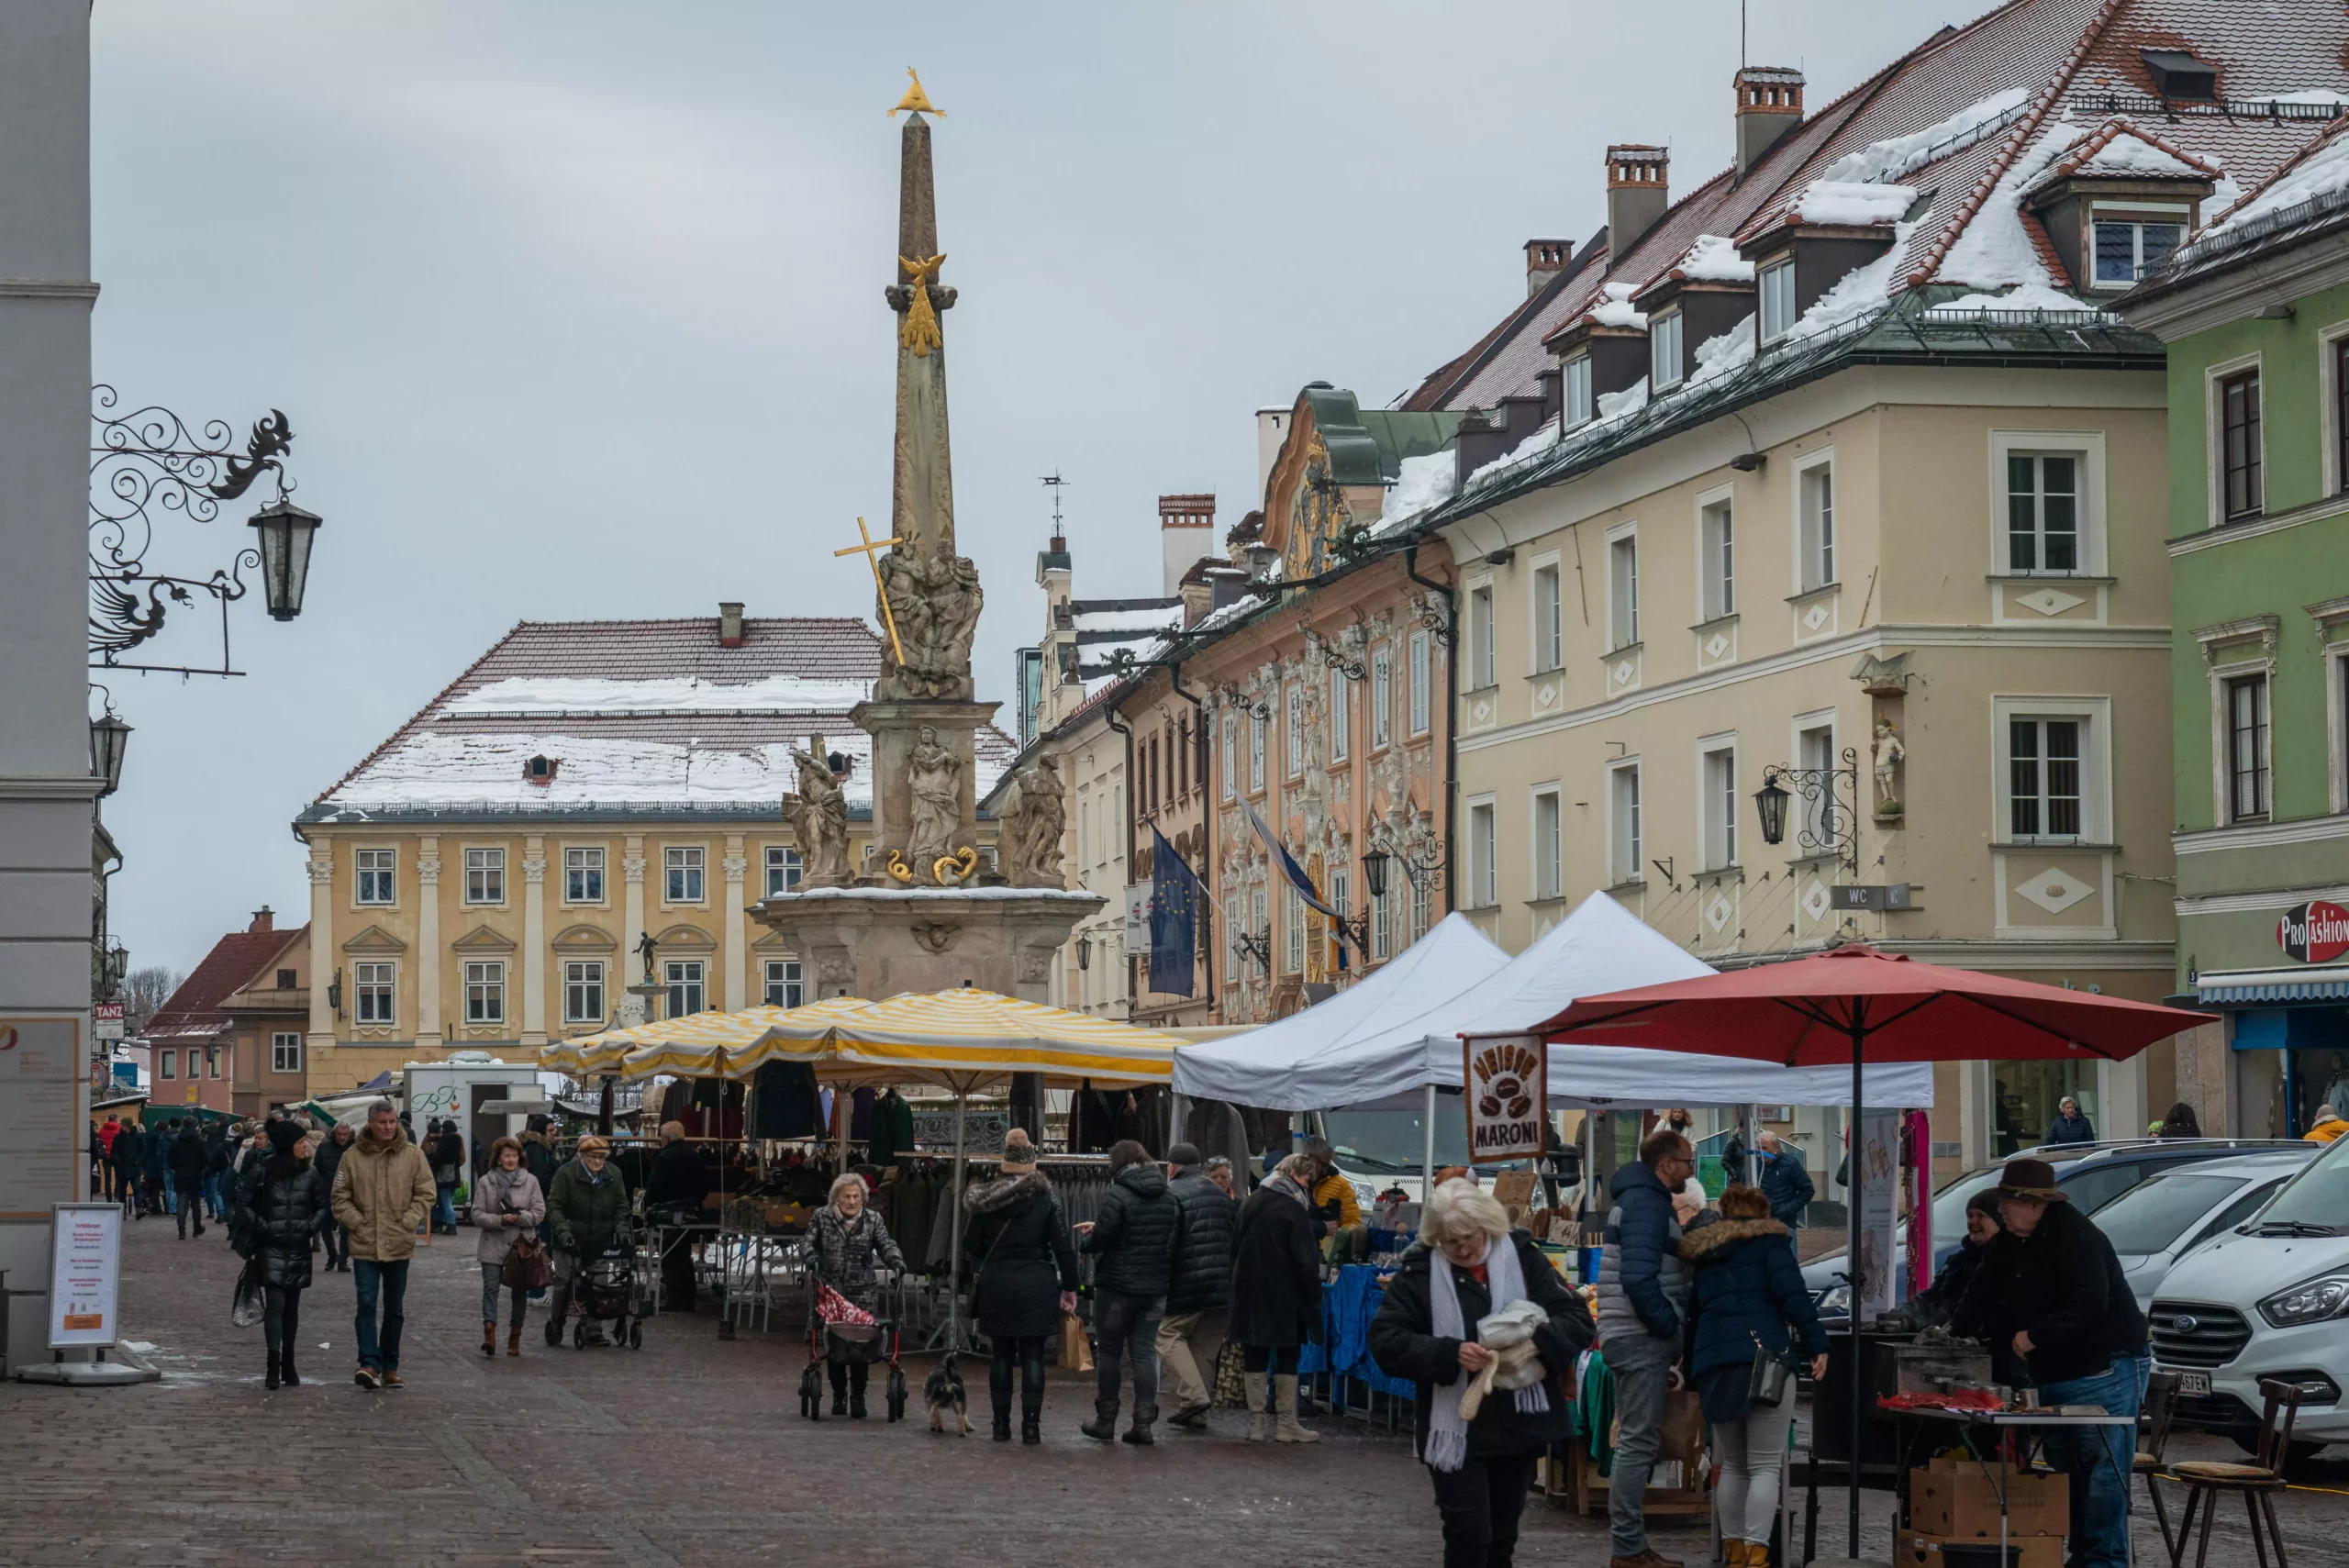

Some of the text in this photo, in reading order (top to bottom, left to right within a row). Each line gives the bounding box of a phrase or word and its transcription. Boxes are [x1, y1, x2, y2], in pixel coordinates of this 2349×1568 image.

[1849, 889, 1867, 903] WC
[1890, 890, 1898, 904] WC
[96, 1006, 123, 1018] TANZ
[1473, 1044, 1539, 1084] HEISSE
[1475, 1121, 1538, 1148] MARONI
